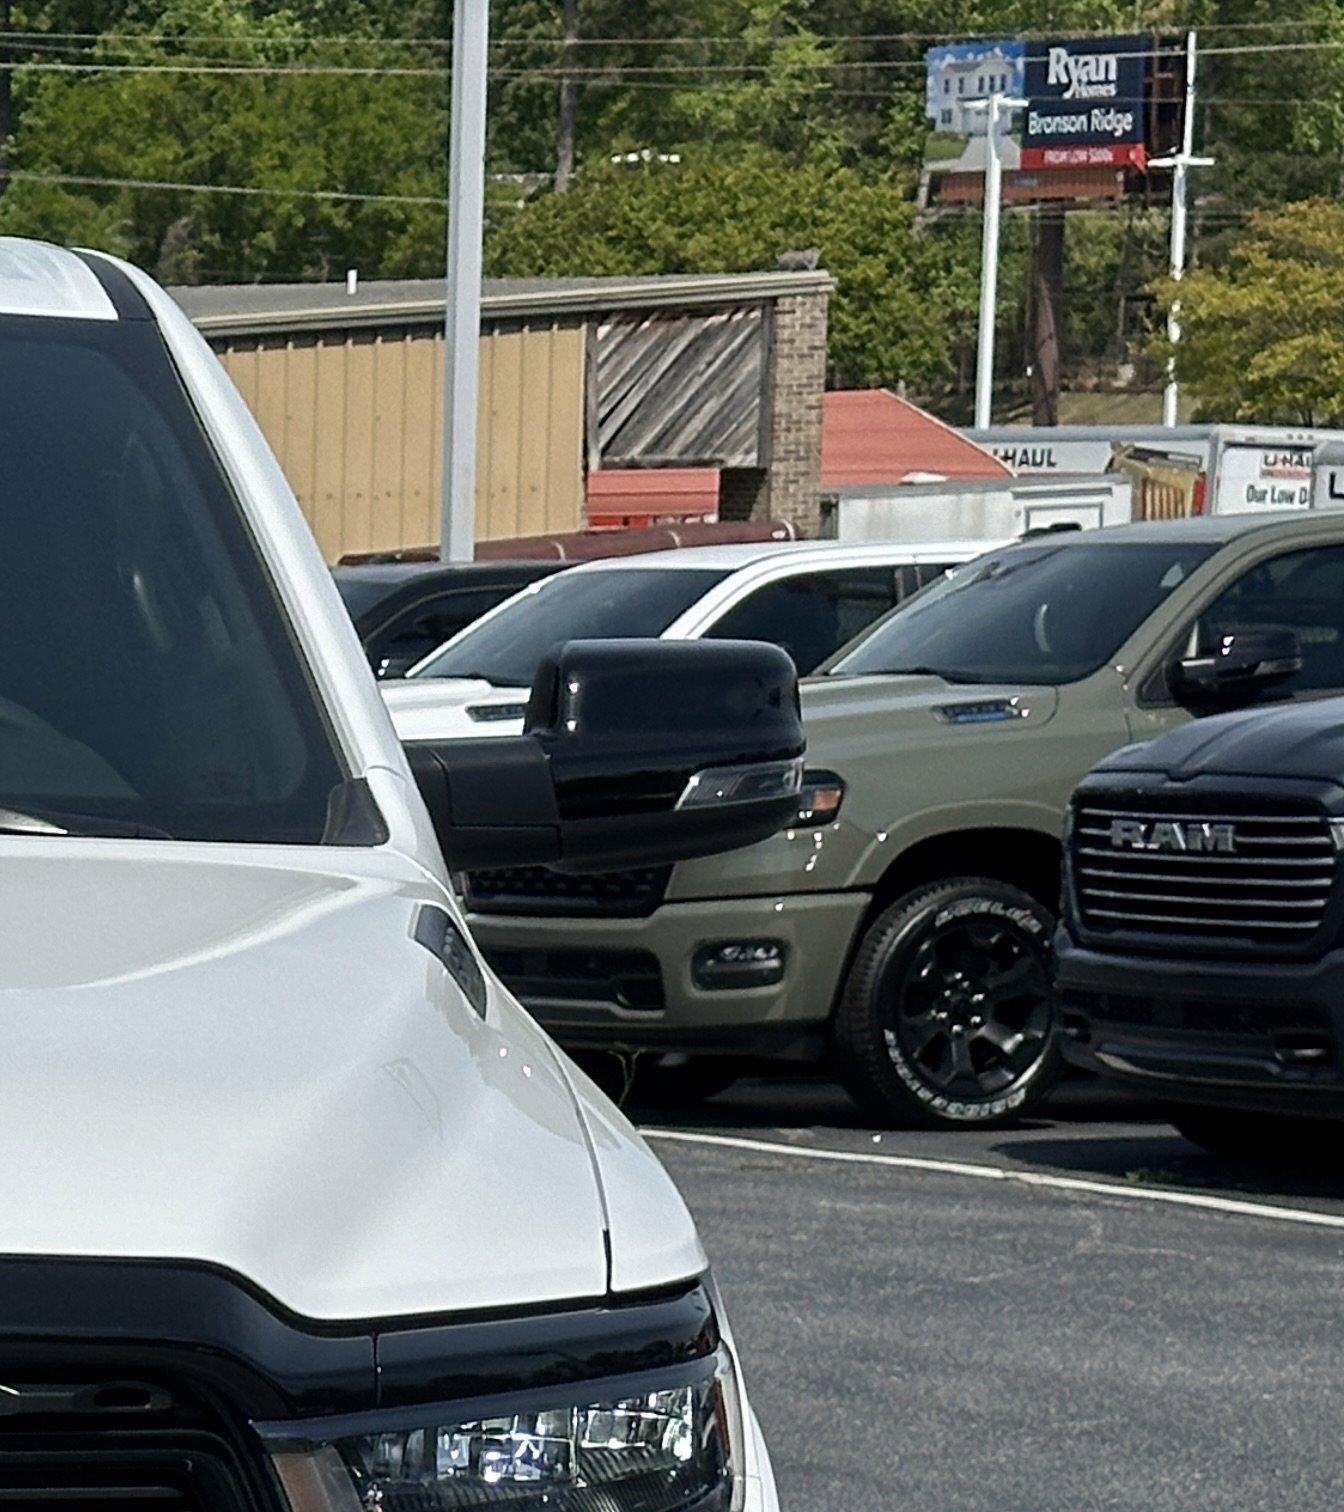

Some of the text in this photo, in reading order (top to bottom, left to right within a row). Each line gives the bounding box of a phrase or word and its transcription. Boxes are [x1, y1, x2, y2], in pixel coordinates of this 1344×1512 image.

[1047, 47, 1116, 99] Ryan
[1028, 108, 1133, 136] Bronson Ridge
[1111, 820, 1237, 852] RAM
